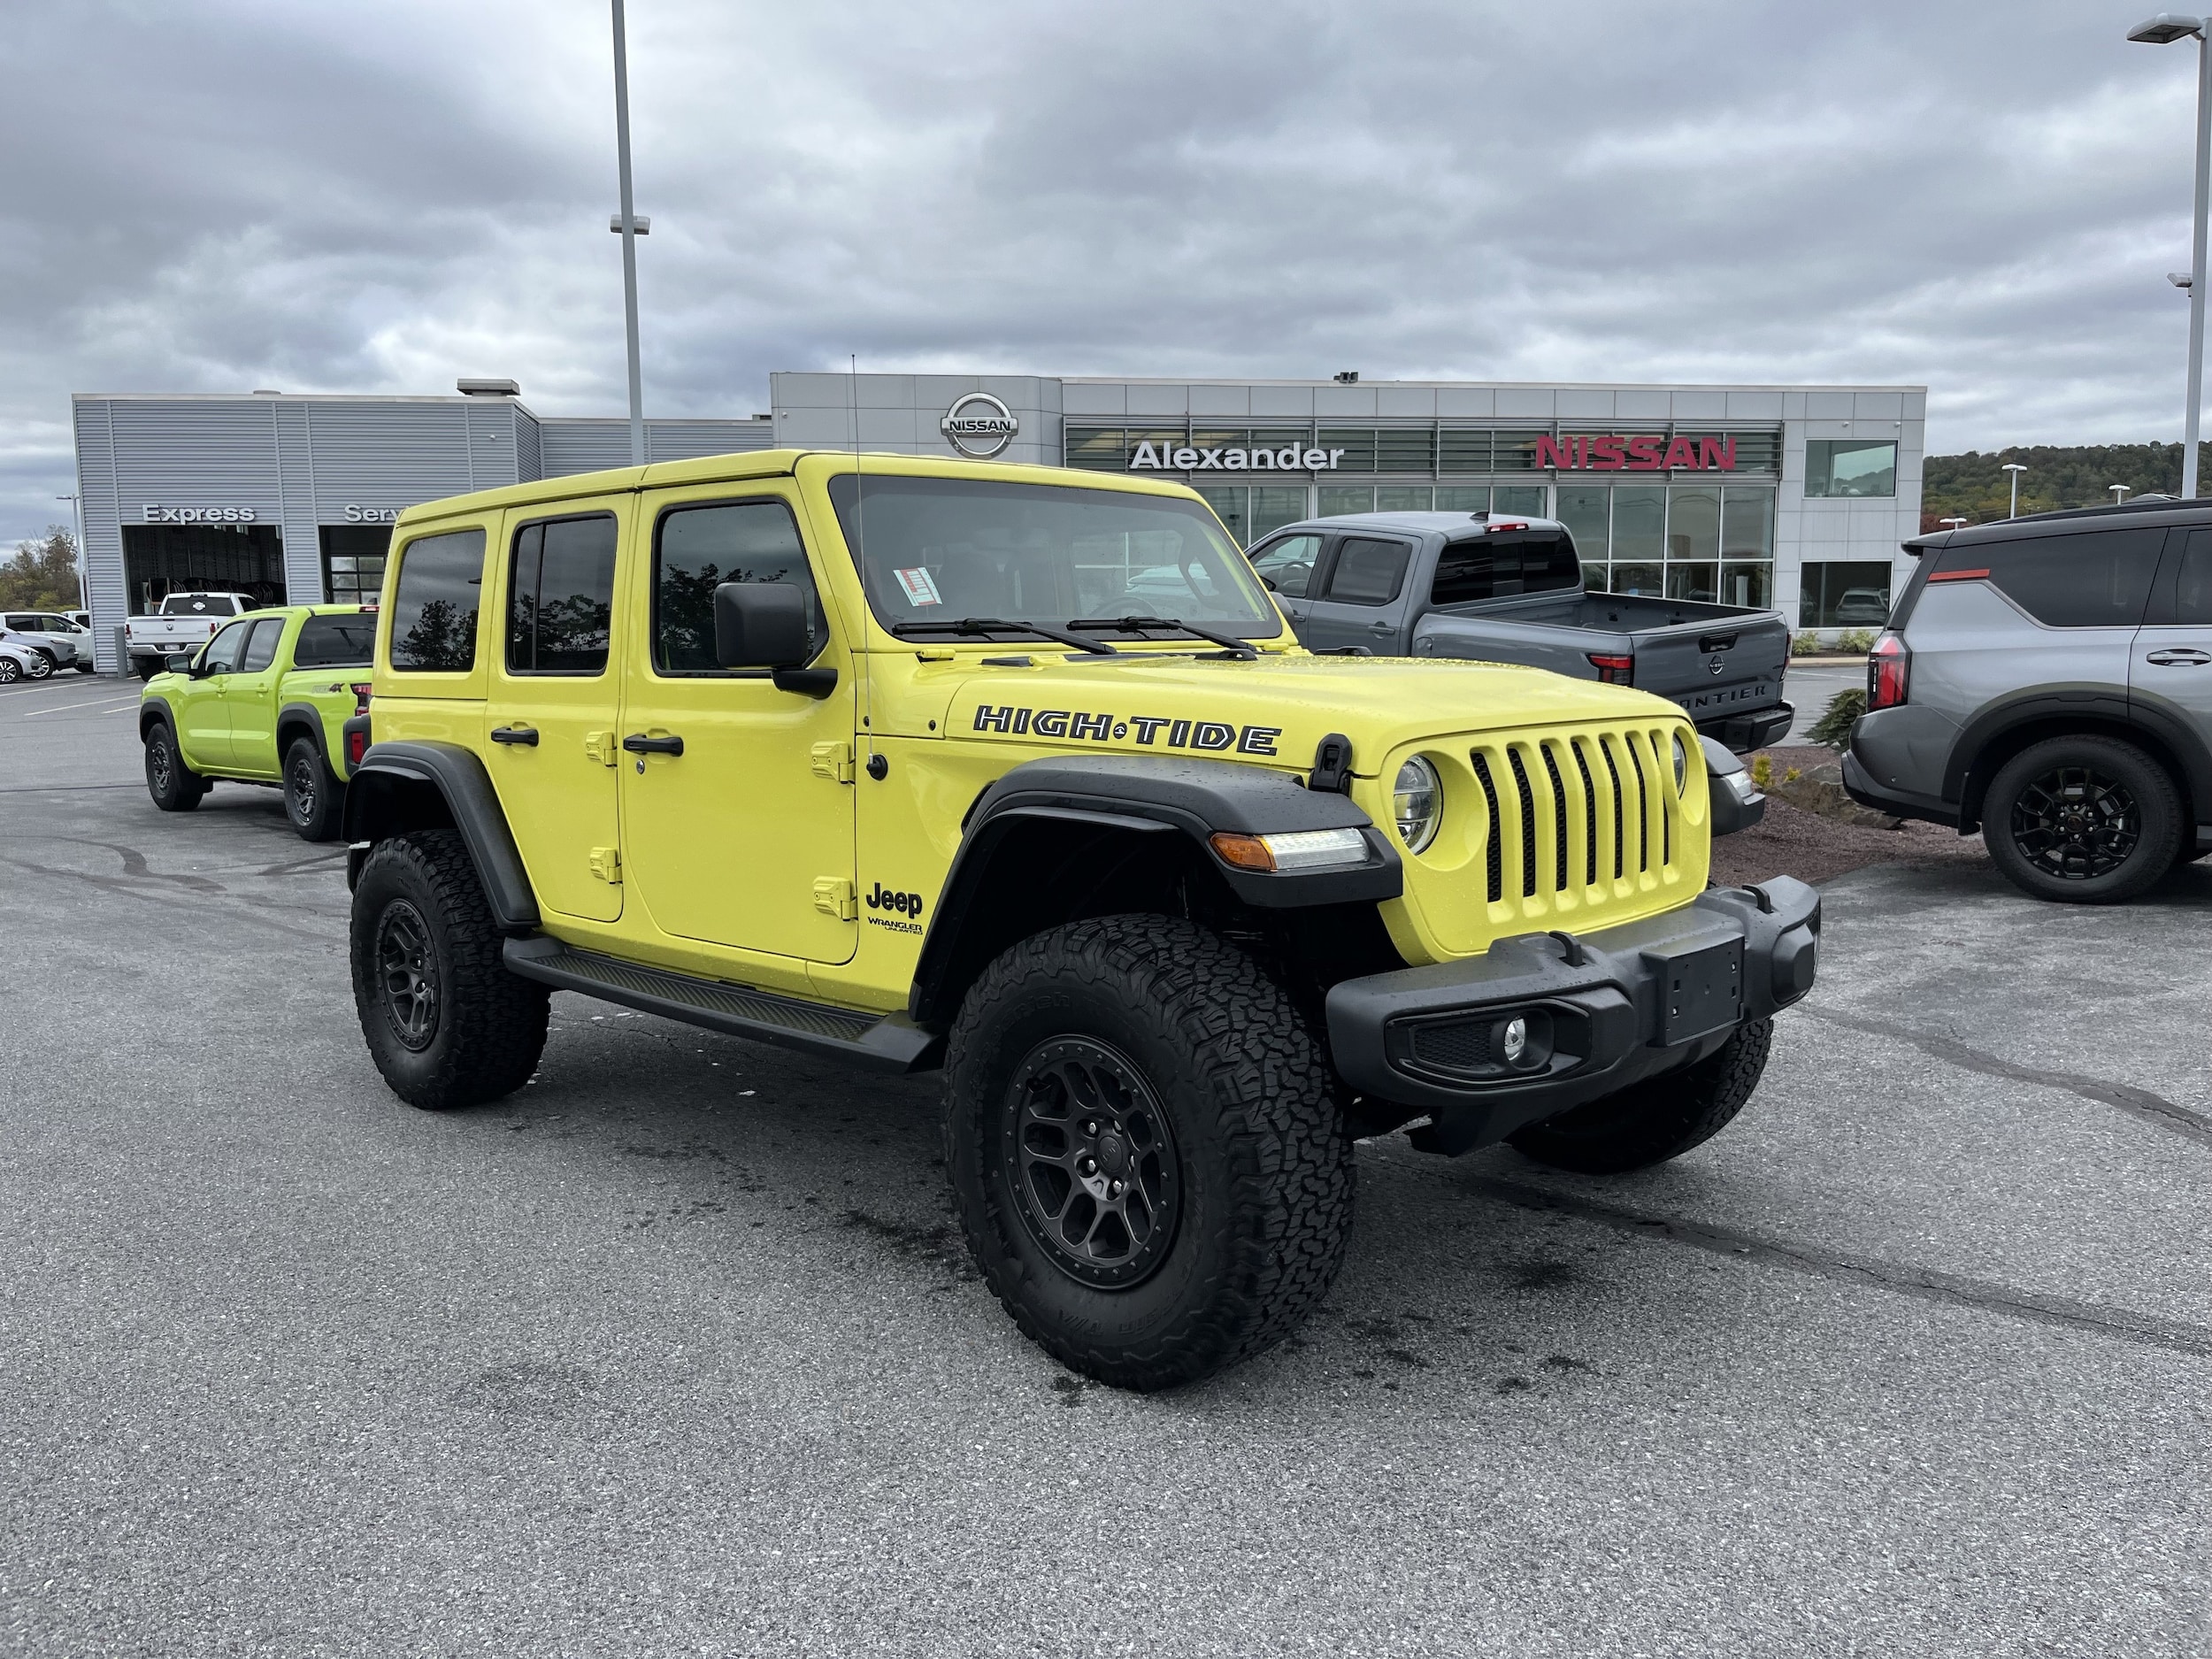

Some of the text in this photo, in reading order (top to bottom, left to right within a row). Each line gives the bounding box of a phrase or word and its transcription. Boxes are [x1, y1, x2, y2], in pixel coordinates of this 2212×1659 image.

[949, 420, 1010, 432] NISSAN
[1130, 442, 1345, 470] Alexander
[1535, 435, 1736, 470] NISSAN
[142, 503, 256, 525] Express
[344, 503, 409, 522] Serv
[1678, 686, 1766, 710] ONTIER
[972, 705, 1283, 756] HIGH TIDE
[866, 881, 923, 919] Jeep
[867, 916, 923, 932] WRANGLER
[884, 926, 923, 935] UNLIMITED
